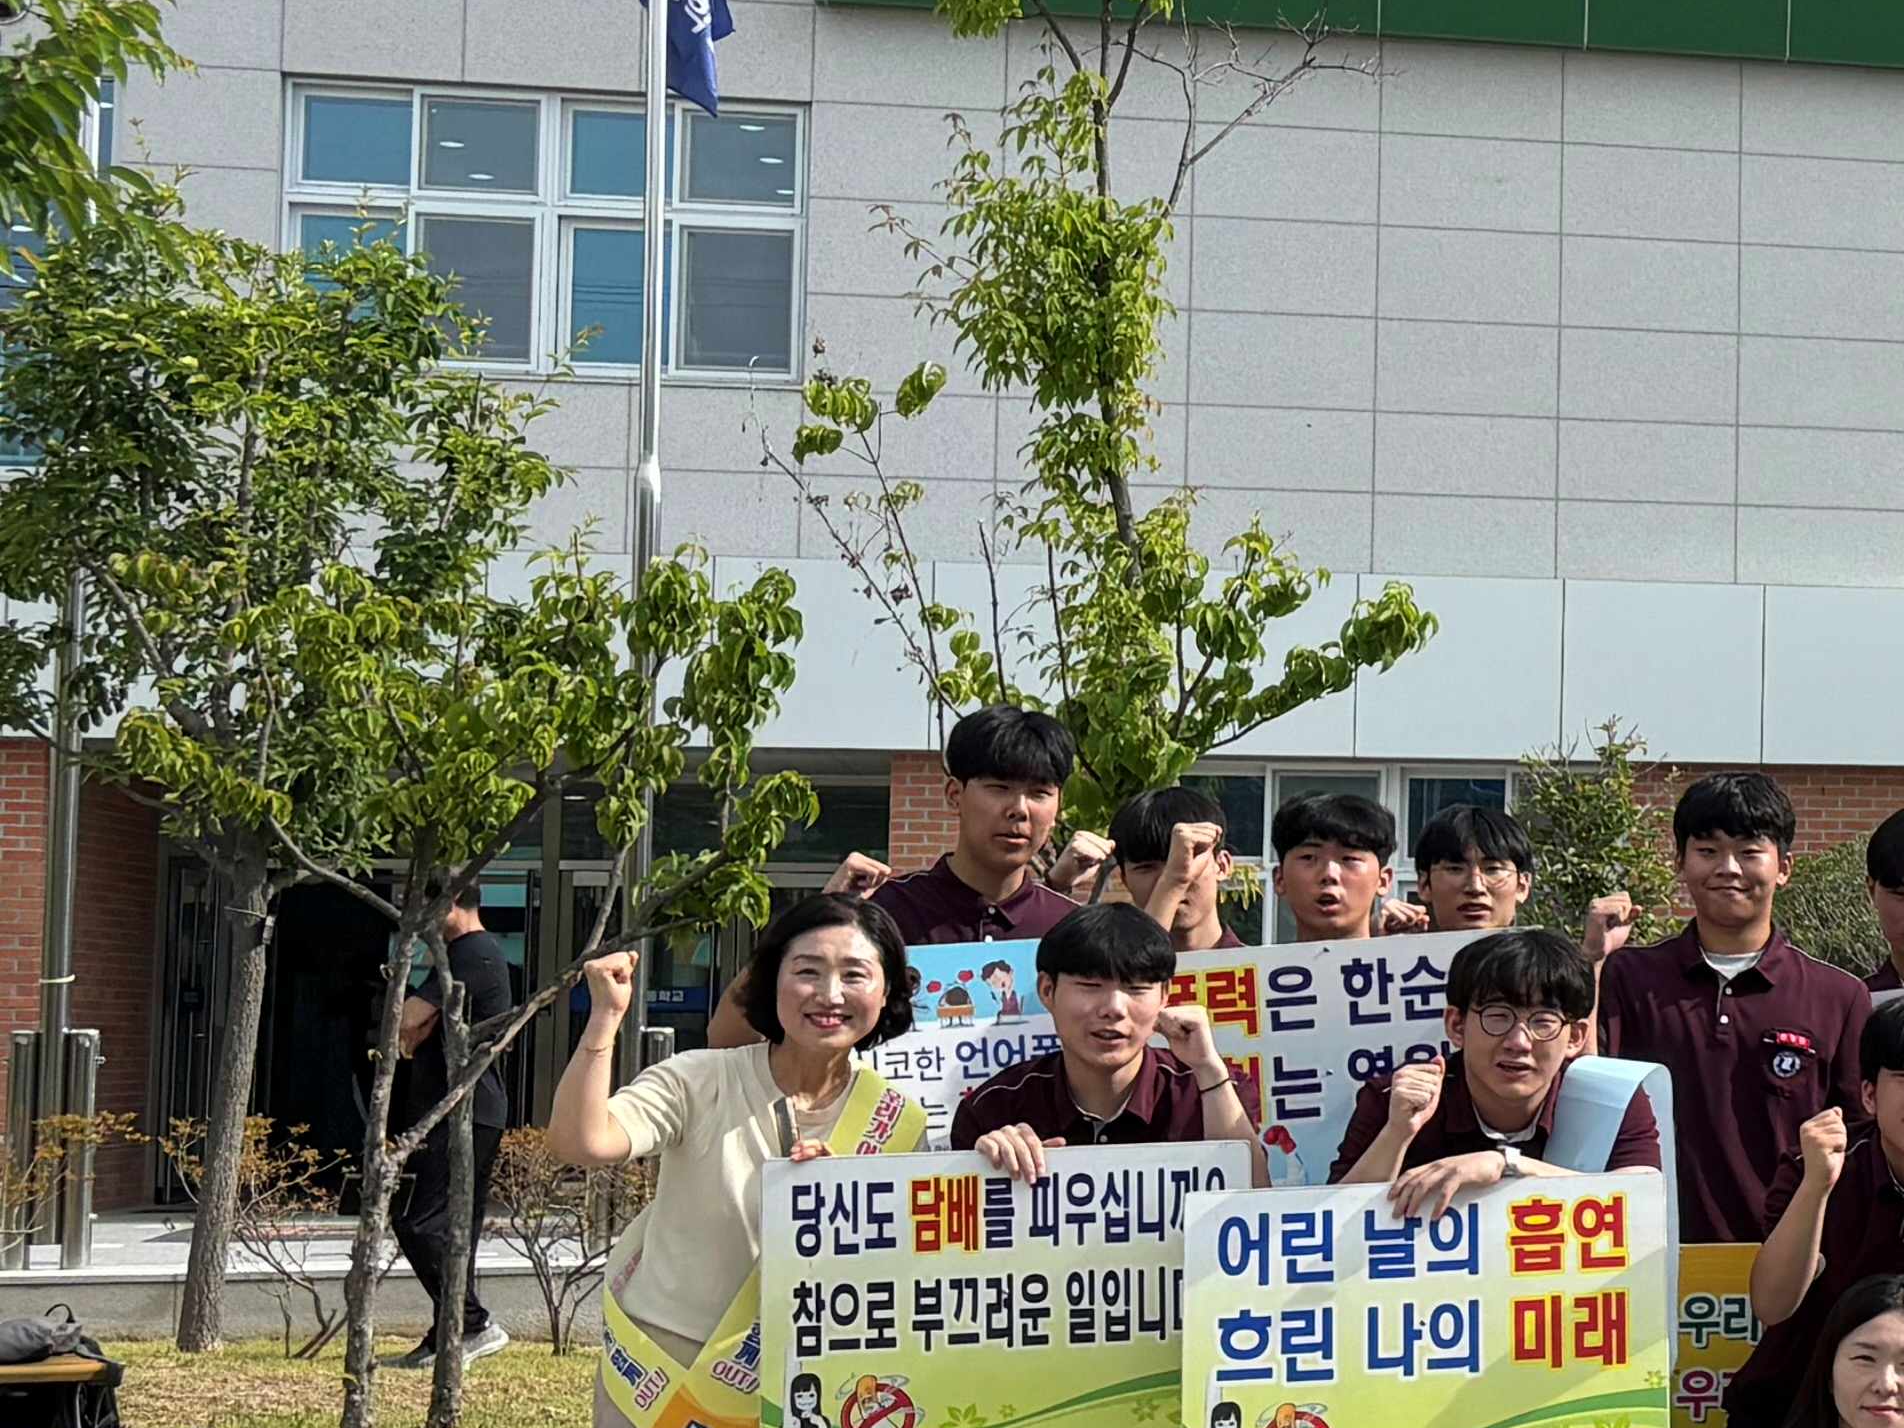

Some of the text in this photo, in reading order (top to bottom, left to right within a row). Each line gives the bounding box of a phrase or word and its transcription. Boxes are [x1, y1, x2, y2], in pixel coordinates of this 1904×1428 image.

[791, 1179, 896, 1257] 당신도
[909, 1174, 1015, 1253] 담배를
[1217, 1193, 1628, 1286] 어린 날의 흡연
[793, 1280, 897, 1357] 참으로
[912, 1272, 1051, 1351] 부끄러운
[1216, 1289, 1629, 1383] 흐린 나의 미래
[633, 1366, 669, 1411] OUT!
[711, 1360, 760, 1394] OUT!
